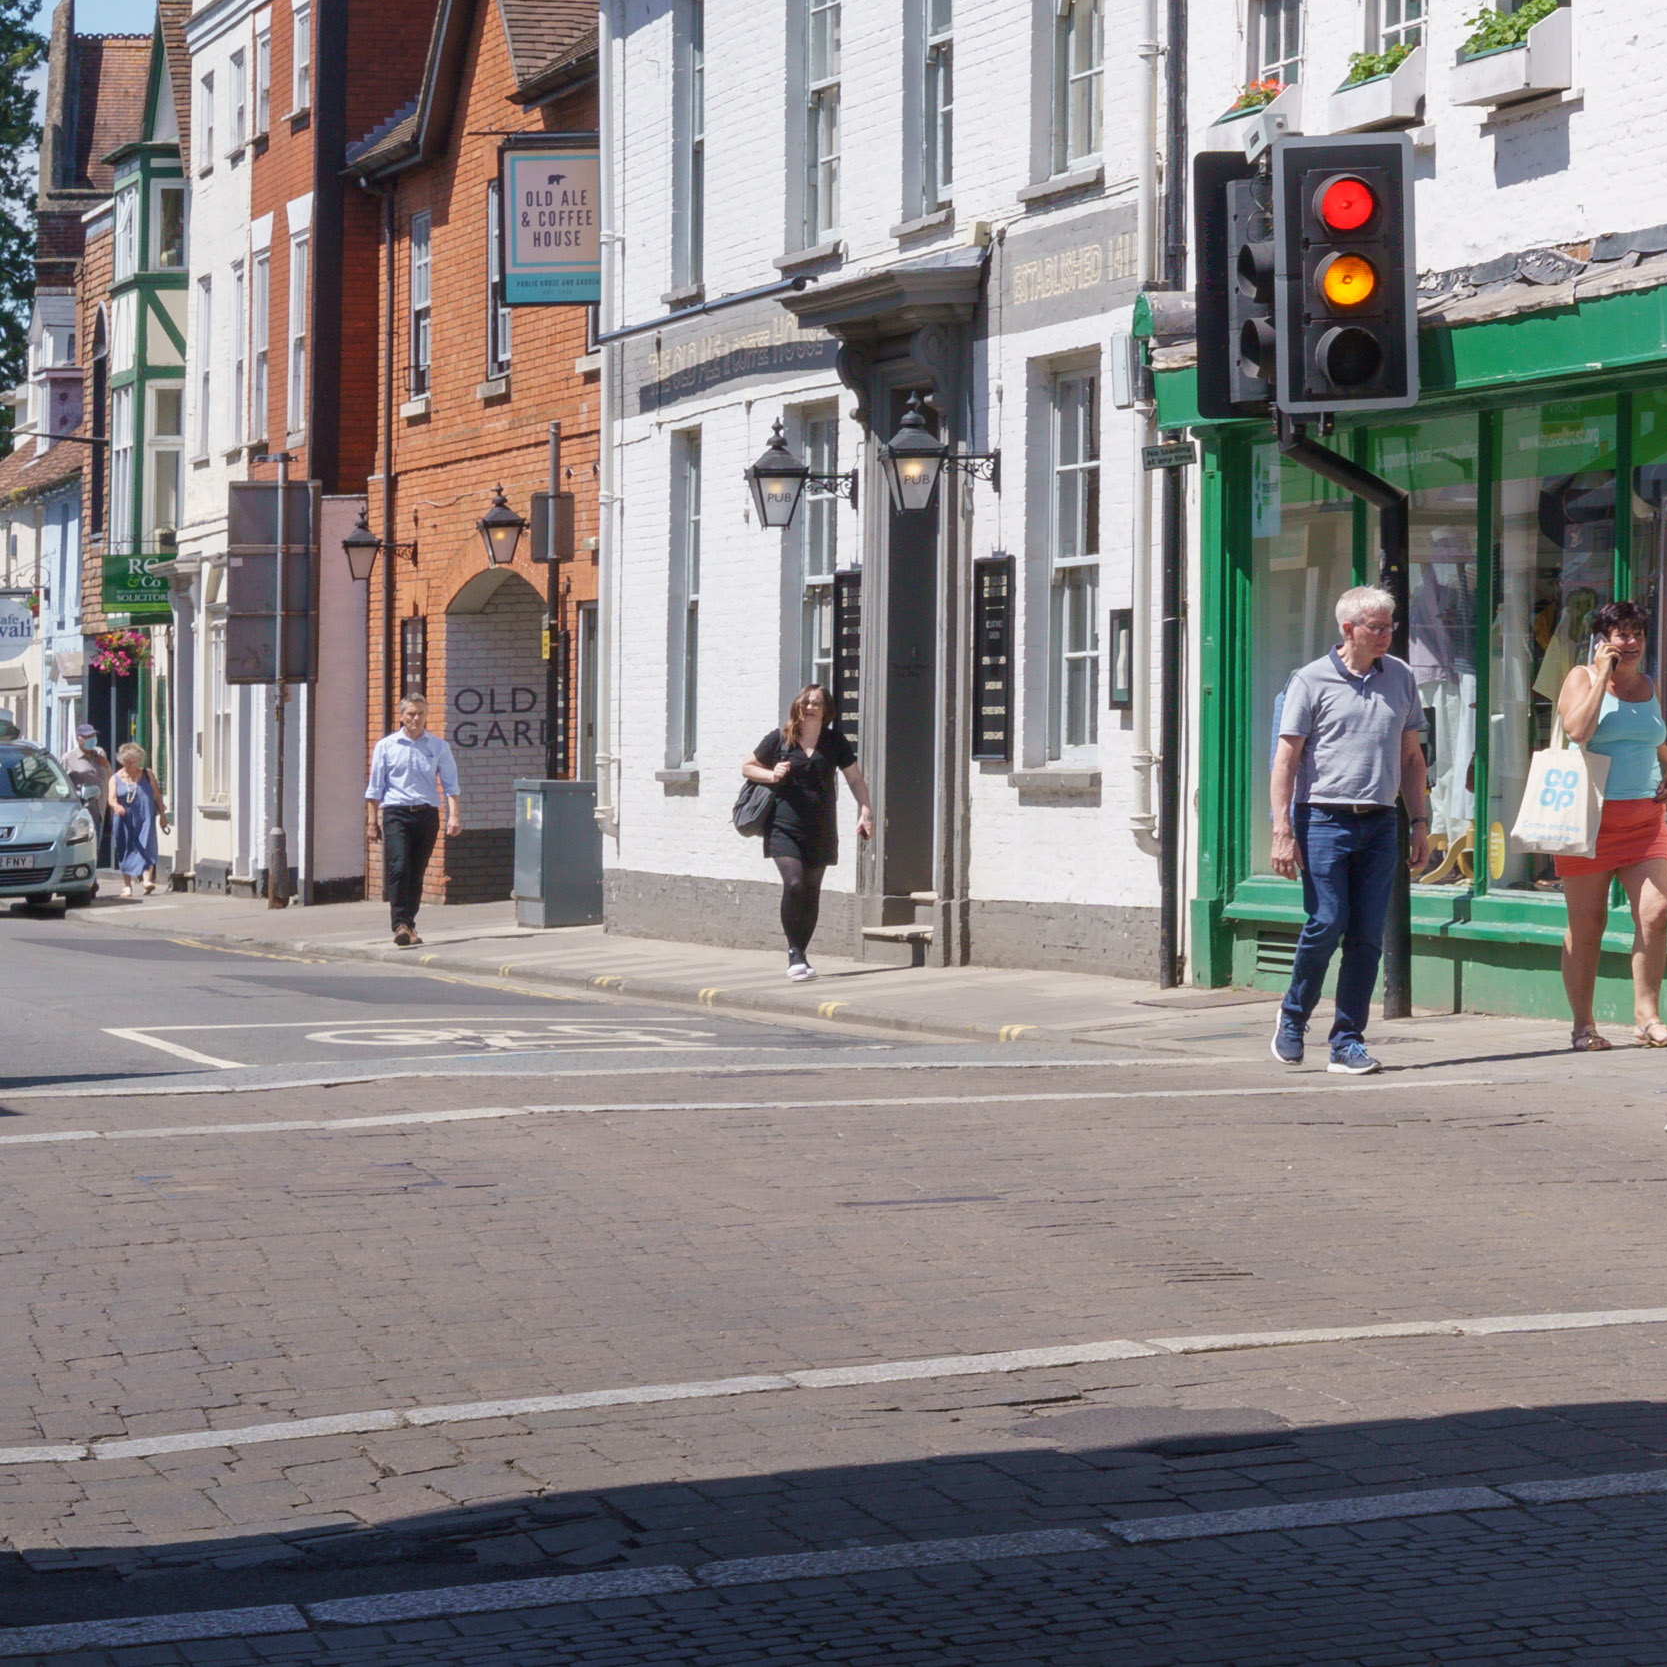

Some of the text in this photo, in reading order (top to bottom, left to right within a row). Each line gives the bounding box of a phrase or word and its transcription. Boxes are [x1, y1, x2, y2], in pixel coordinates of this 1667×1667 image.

[526, 190, 588, 207] OLD ALE
[521, 210, 593, 228] & COFFEE
[533, 230, 582, 248] HOUSE
[1013, 244, 1103, 305] ESTABLISHED
[671, 341, 697, 389] OLD
[701, 334, 721, 383] ALE
[731, 329, 771, 373] COFFEE
[1147, 446, 1191, 457] No loading
[1158, 457, 1172, 466] any
[1175, 454, 1193, 462] time
[904, 474, 931, 485] PUB
[767, 492, 792, 503] PUB
[127, 575, 162, 588] & Co
[116, 594, 168, 602] SOLICITOR
[0, 613, 19, 625] afe
[454, 687, 537, 714] OLD
[453, 720, 547, 747] GAR
